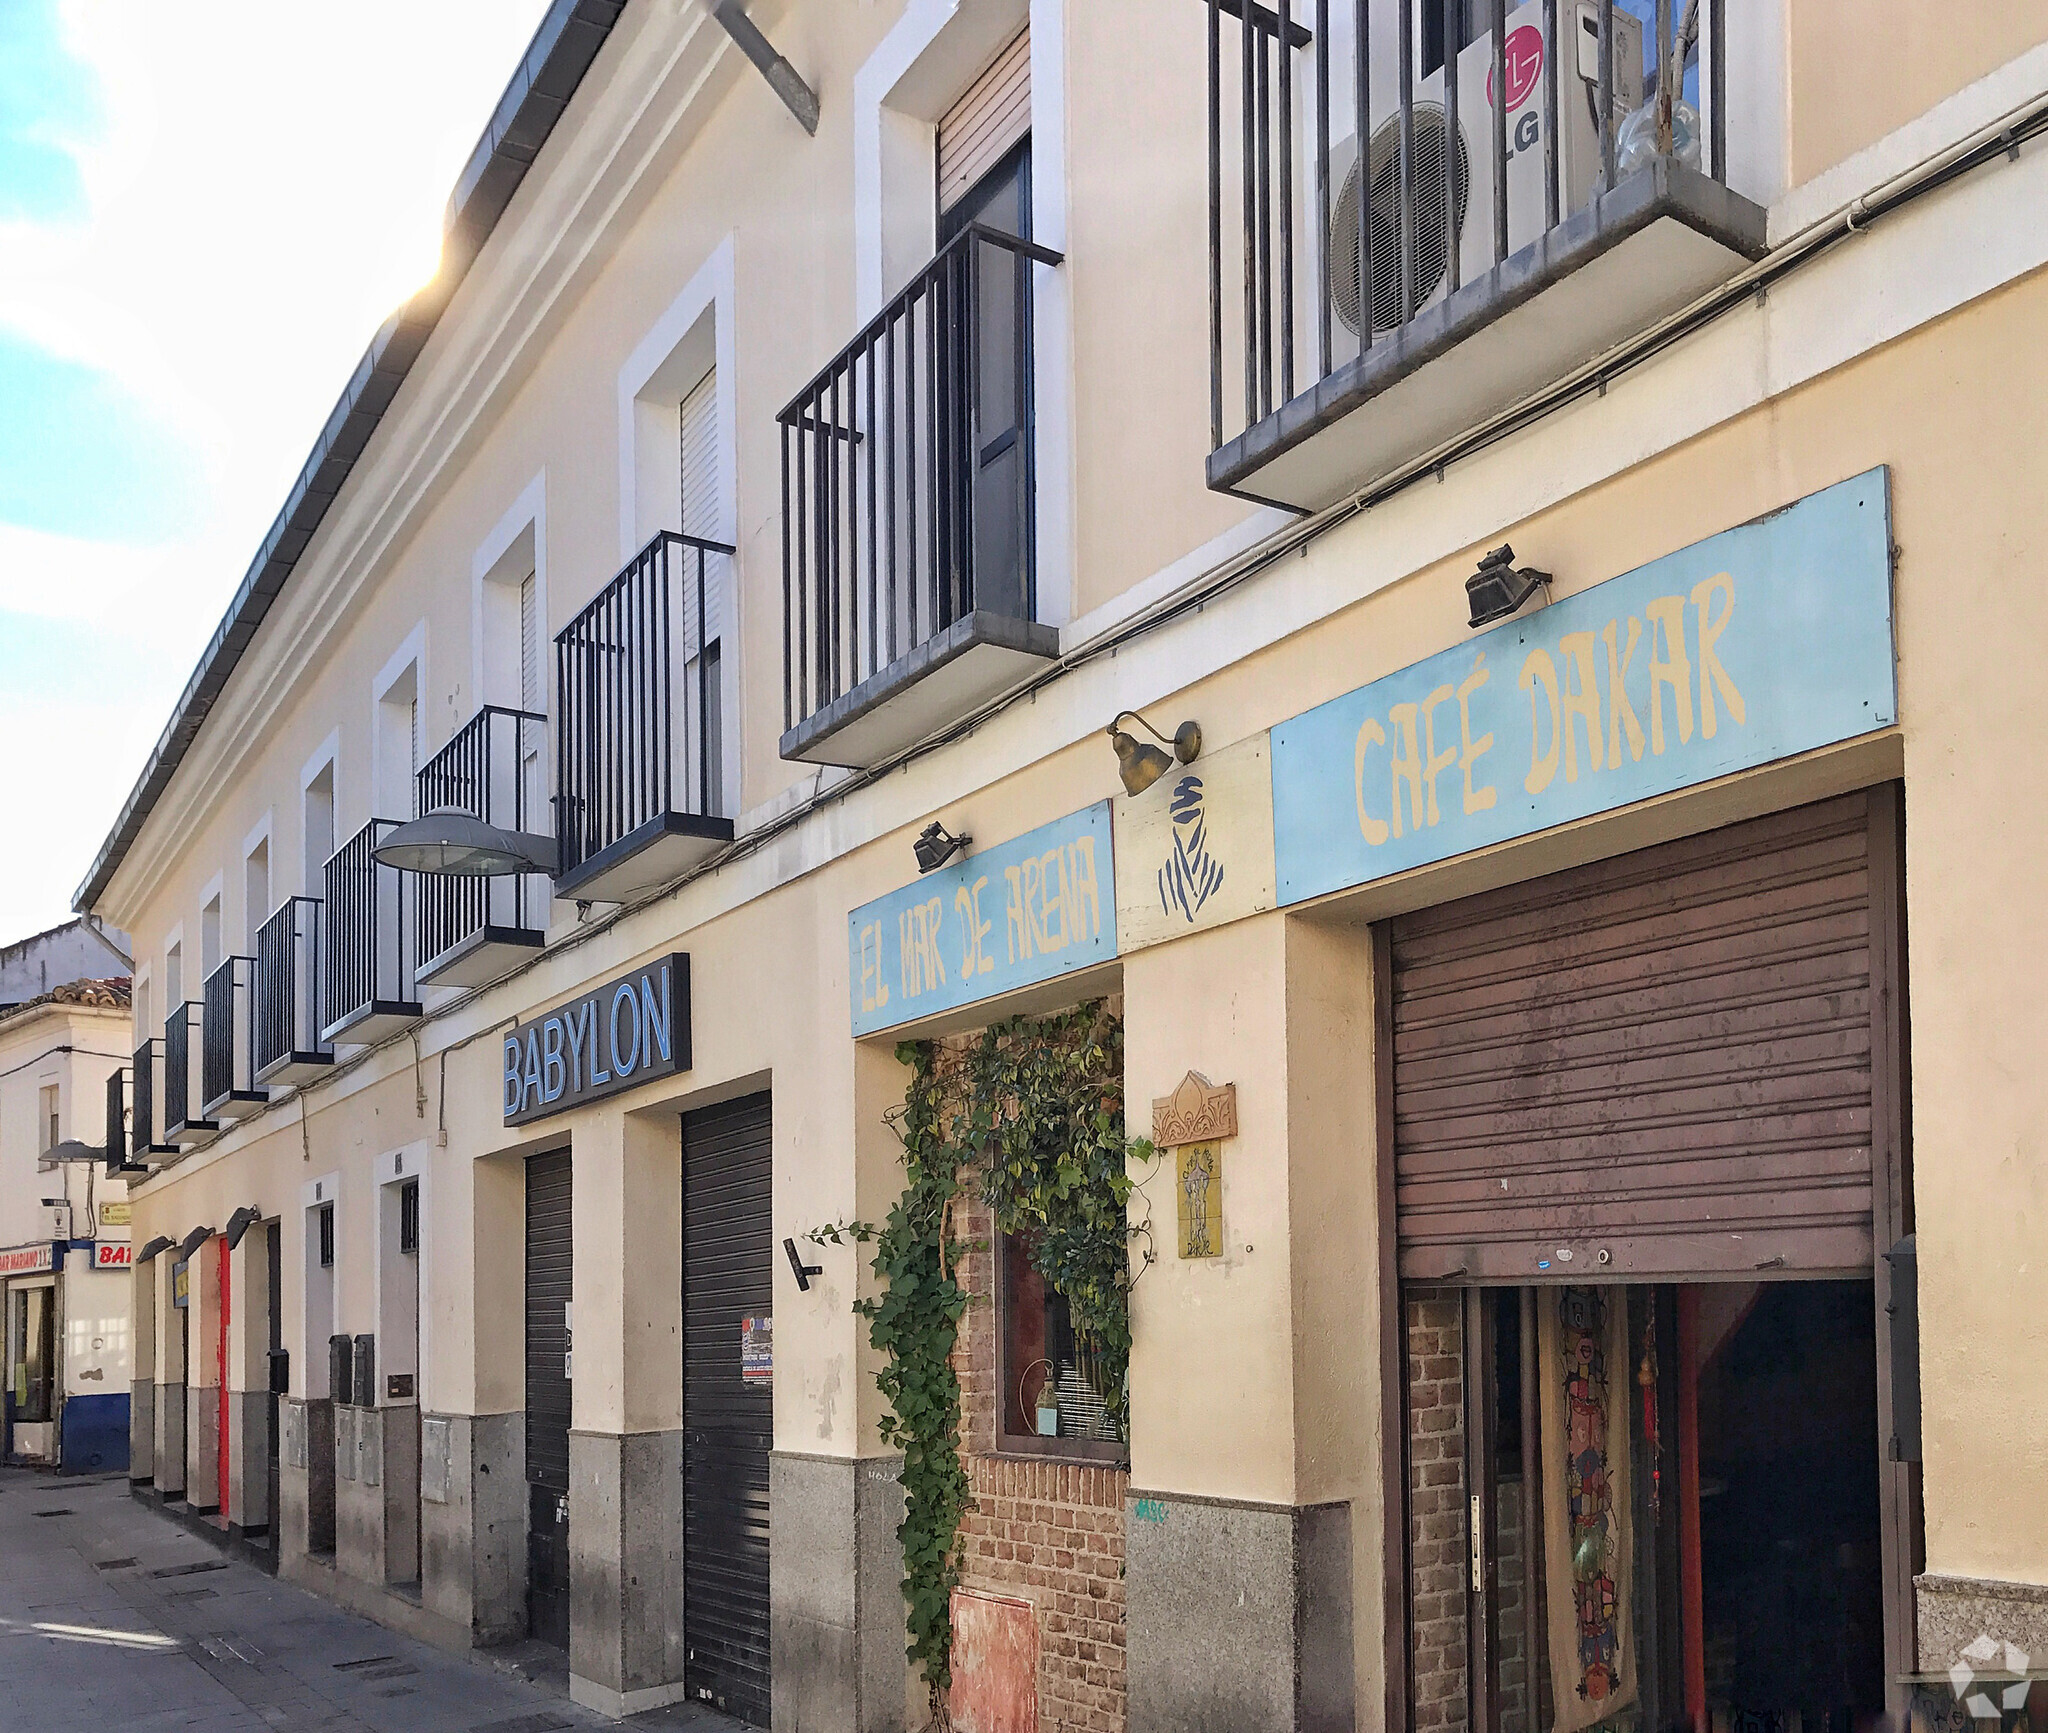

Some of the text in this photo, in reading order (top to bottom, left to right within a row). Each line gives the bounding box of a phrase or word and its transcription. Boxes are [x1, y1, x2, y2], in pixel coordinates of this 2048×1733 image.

[1504, 110, 1539, 162] G
[1354, 571, 1746, 845] CAFÉ DAKAR
[859, 834, 1102, 1013] EL MAR DE ARENA
[503, 965, 673, 1118] BABYLON
